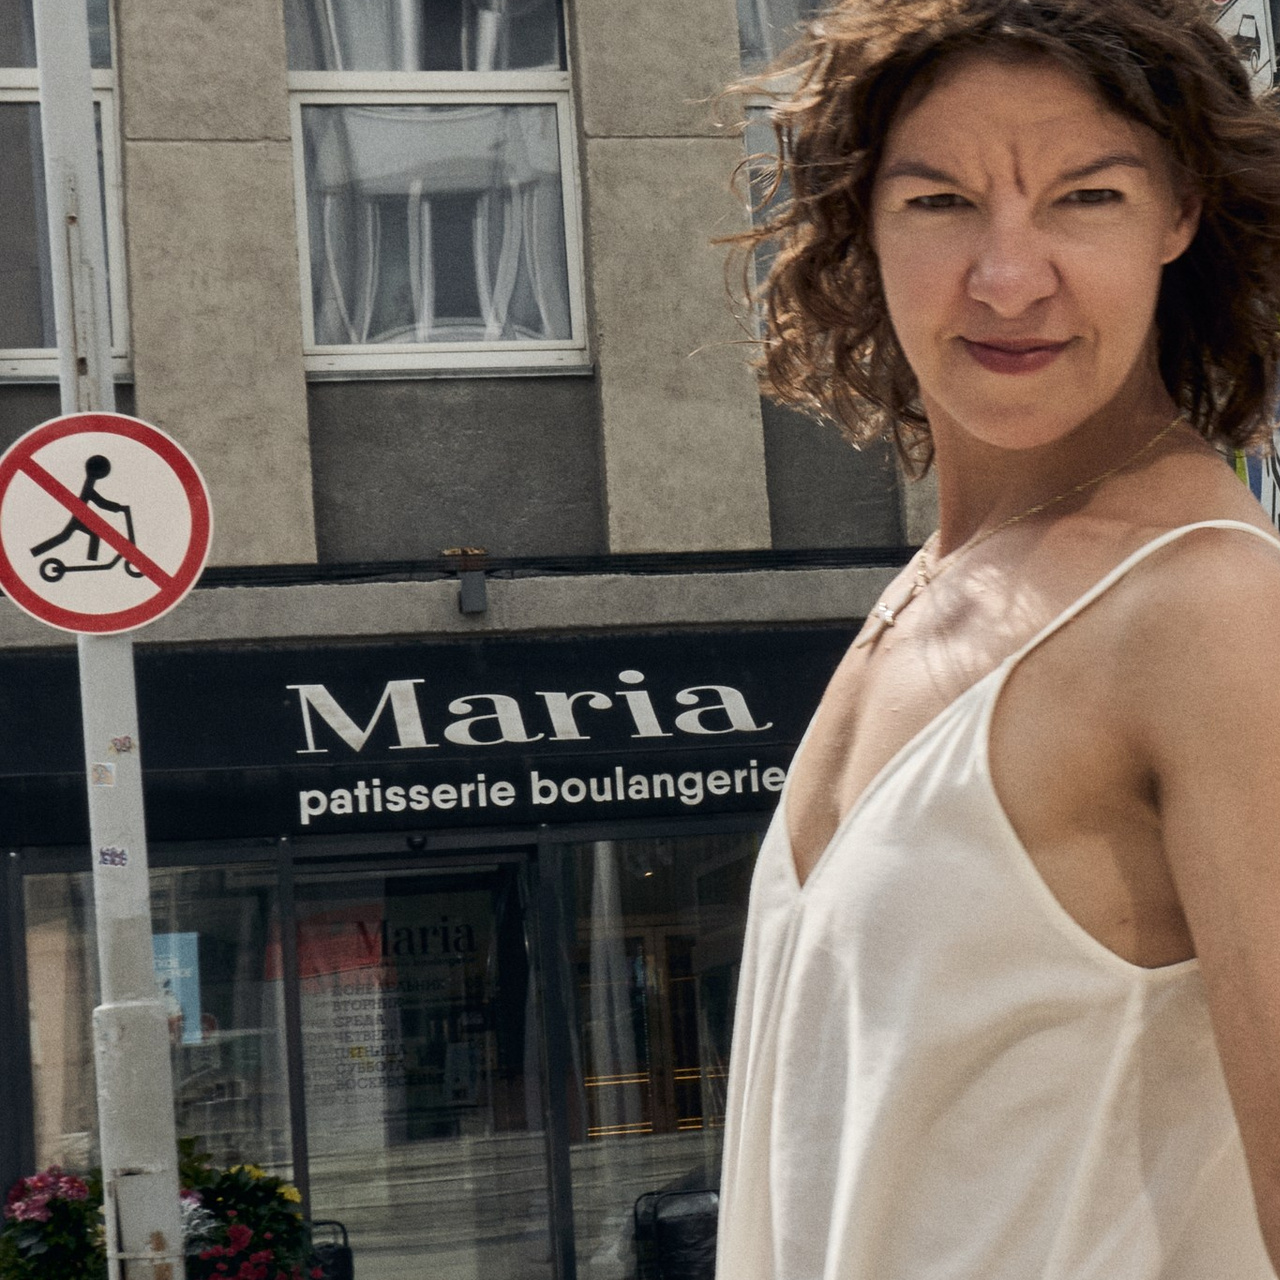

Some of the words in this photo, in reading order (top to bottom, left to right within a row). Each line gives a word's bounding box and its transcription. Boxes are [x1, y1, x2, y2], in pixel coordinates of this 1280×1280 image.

[286, 669, 773, 753] Maria
[299, 773, 516, 824] patisserie
[531, 760, 787, 806] boulangerie
[356, 916, 476, 957] Maria
